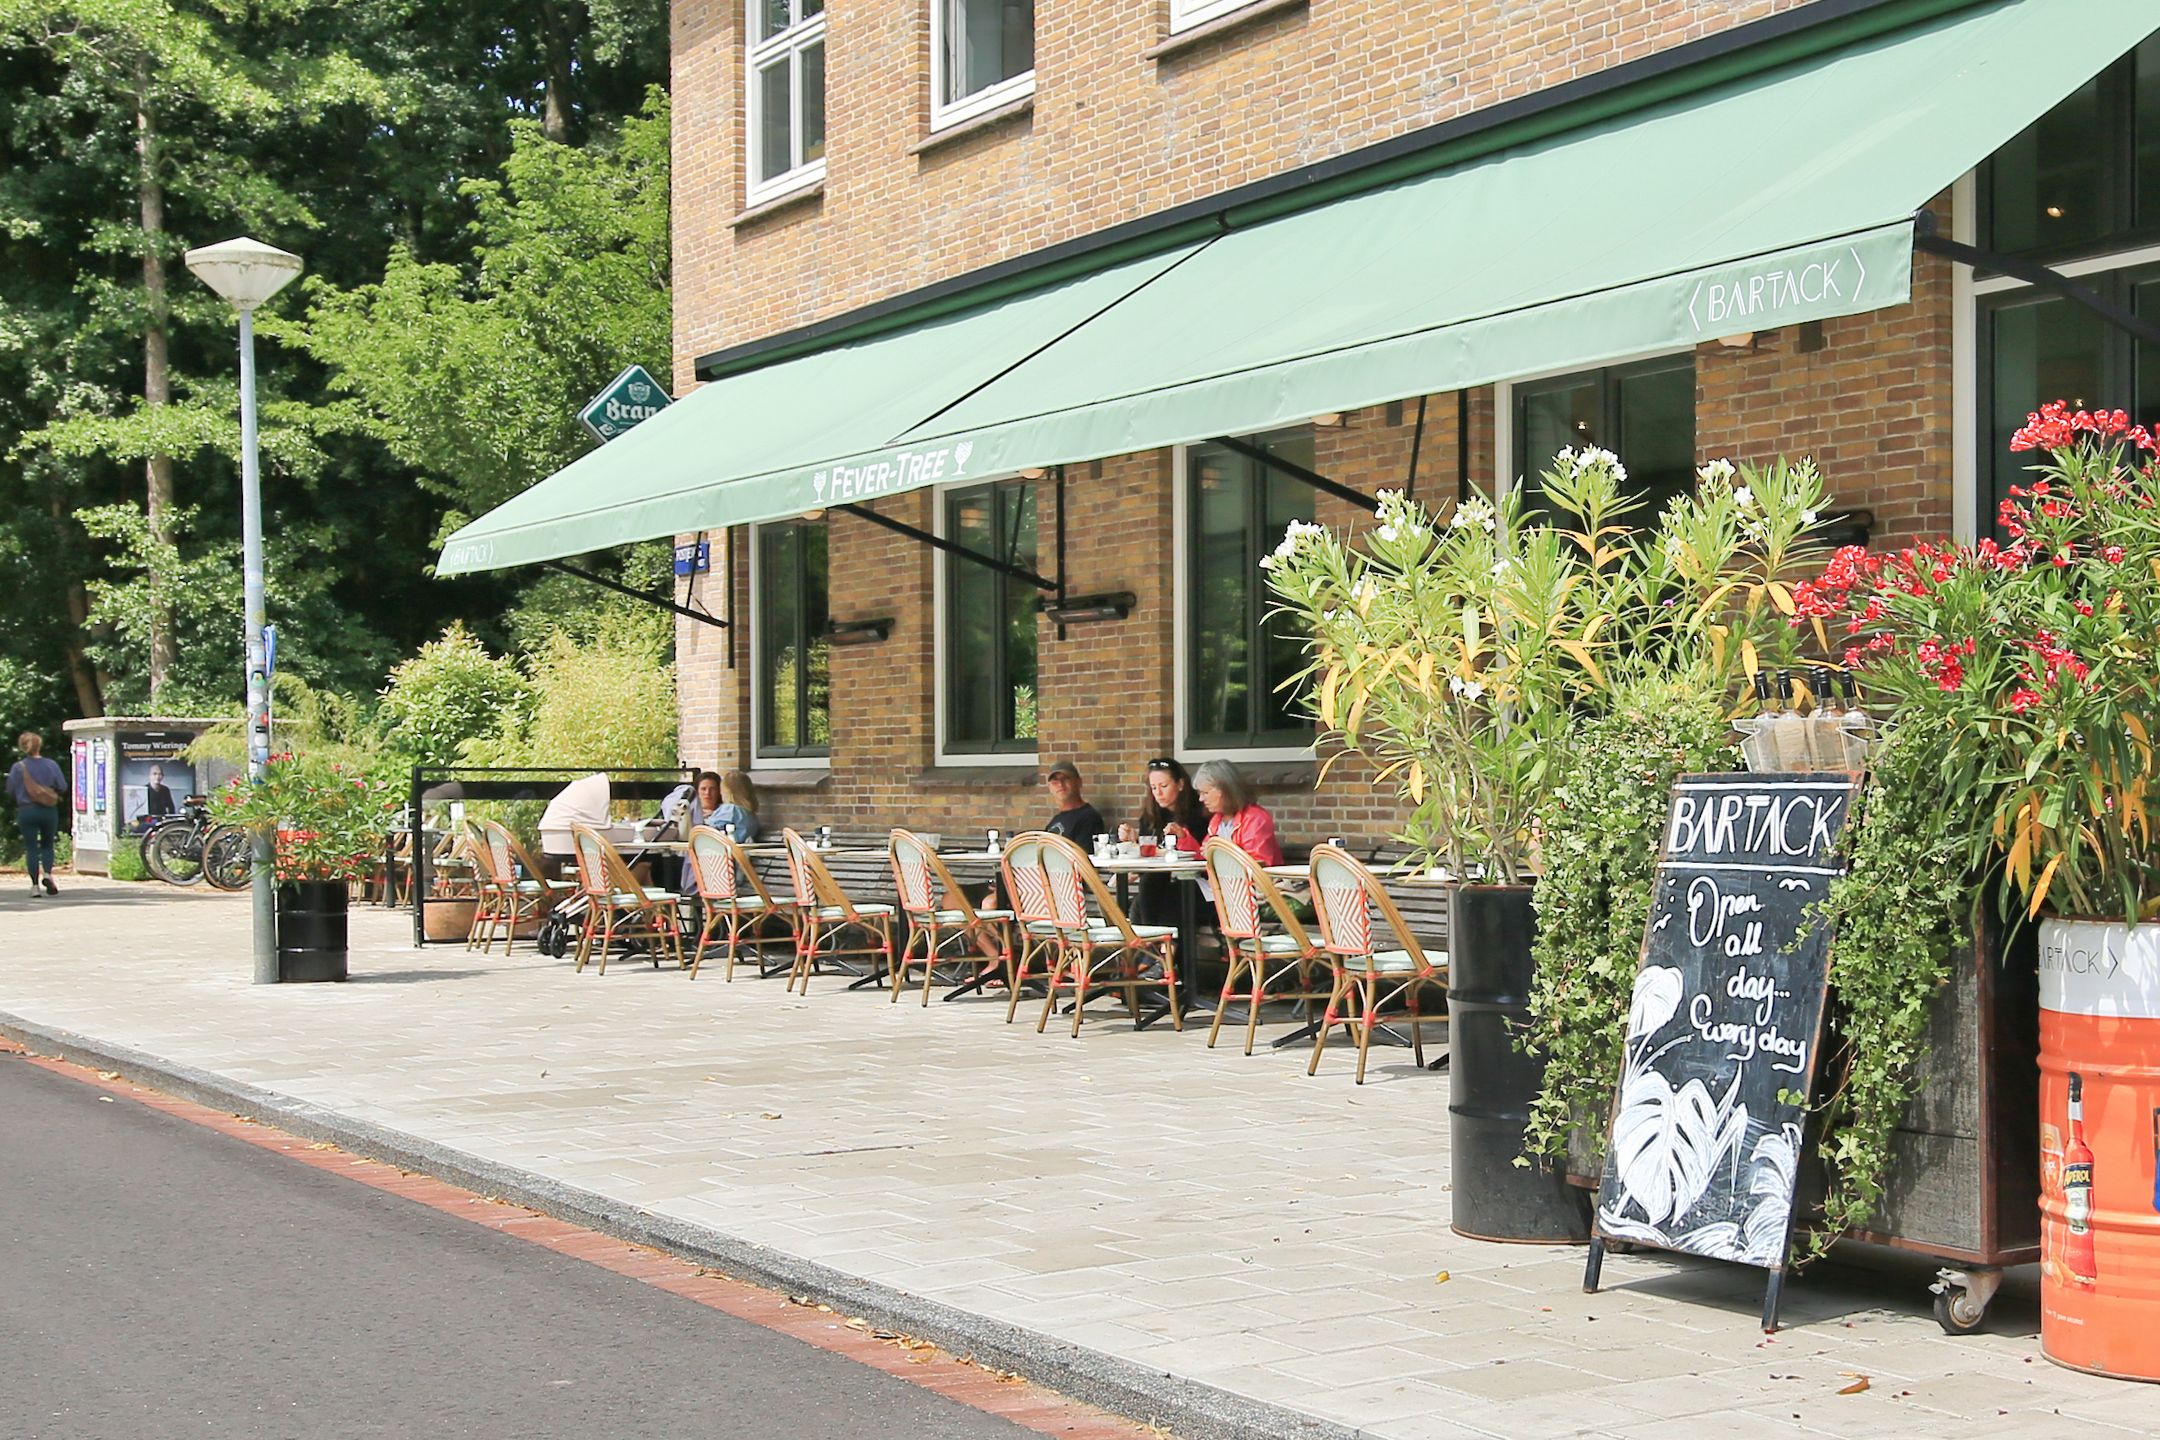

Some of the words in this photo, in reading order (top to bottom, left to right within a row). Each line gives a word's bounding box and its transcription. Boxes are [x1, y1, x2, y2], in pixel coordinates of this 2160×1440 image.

[1707, 259, 1842, 323] BARTACK
[606, 397, 669, 421] Bran
[830, 448, 950, 500] FEVER-TREE
[122, 742, 151, 752] Tommy
[1667, 794, 1842, 858] BARTACK
[1687, 876, 1765, 947] Open
[1724, 921, 1763, 957] all
[2064, 1170, 2090, 1187] APEROL
